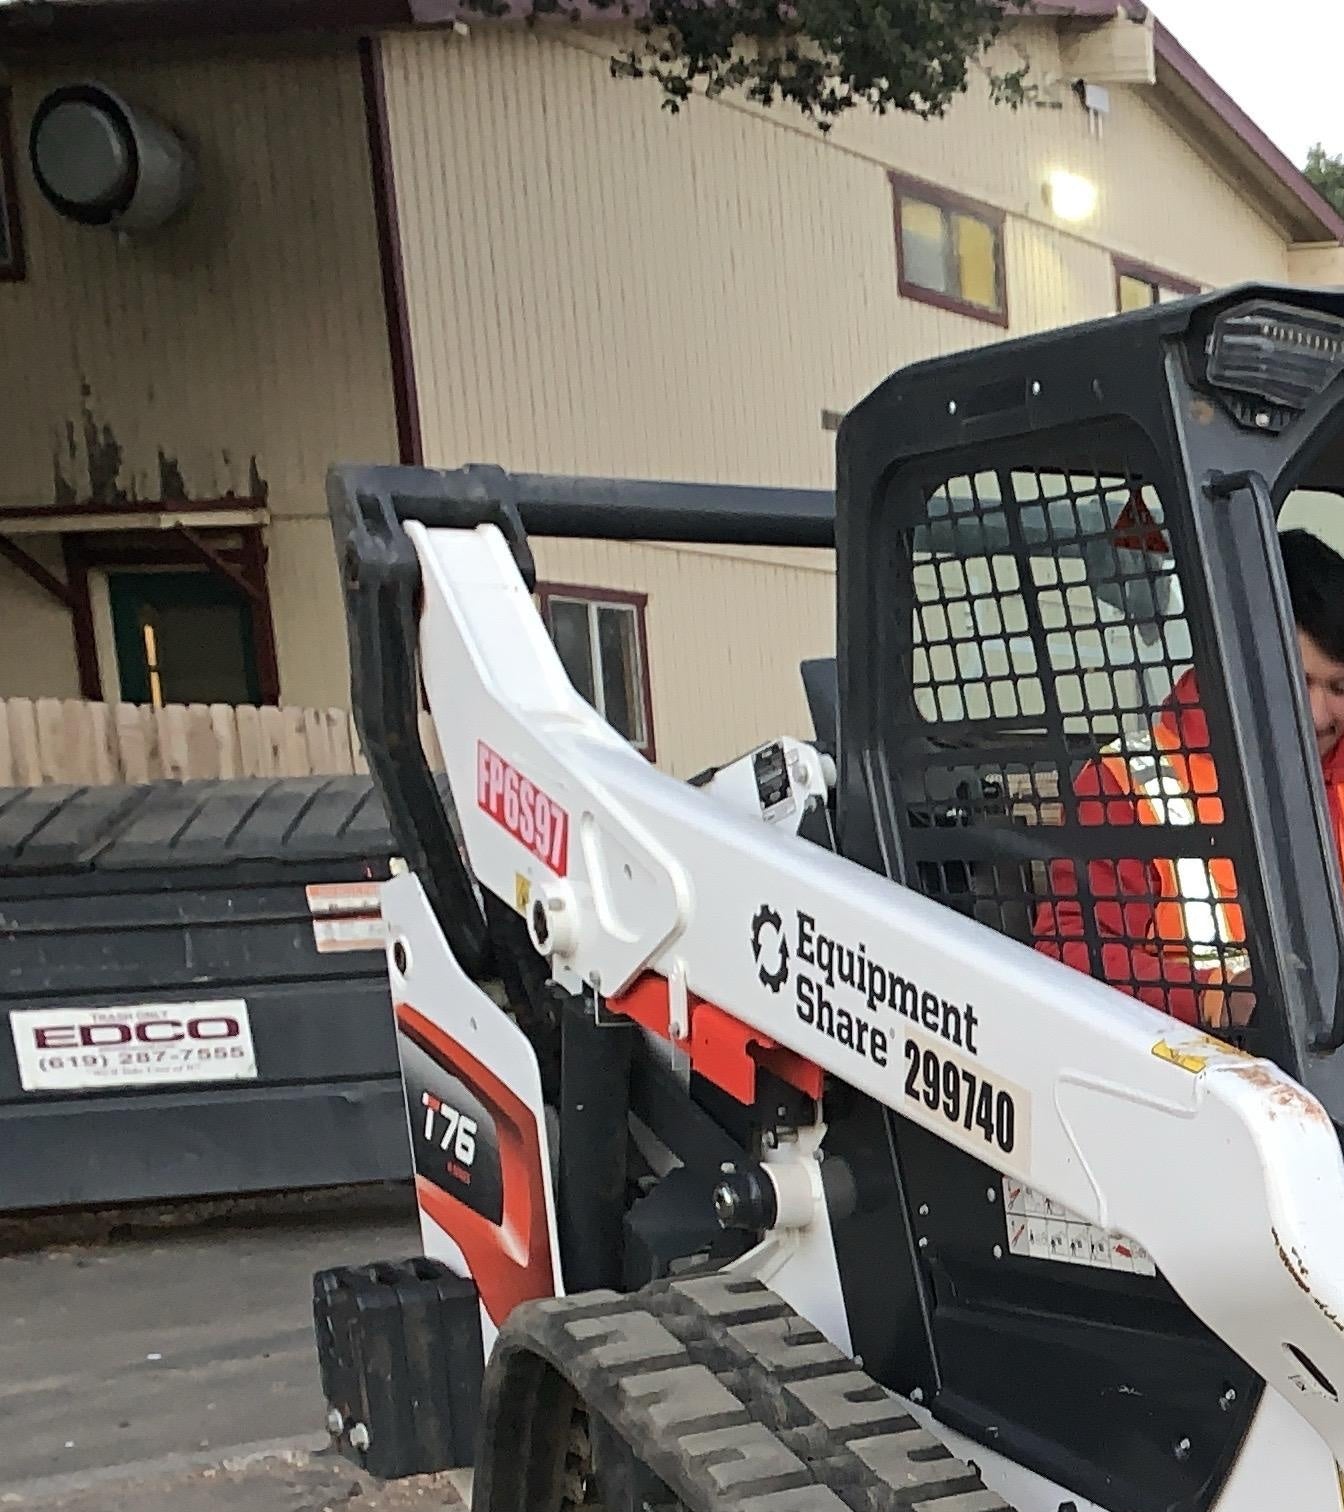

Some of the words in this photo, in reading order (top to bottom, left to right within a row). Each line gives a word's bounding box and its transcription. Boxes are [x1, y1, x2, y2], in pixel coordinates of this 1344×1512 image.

[796, 911, 979, 1055] Equipment
[797, 975, 889, 1067] Share
[34, 1017, 241, 1050] EDCO
[39, 1055, 108, 1072] (619)
[119, 1046, 245, 1066] 287-7555
[422, 1092, 478, 1166] T76
[904, 1039, 1015, 1153] 299740
